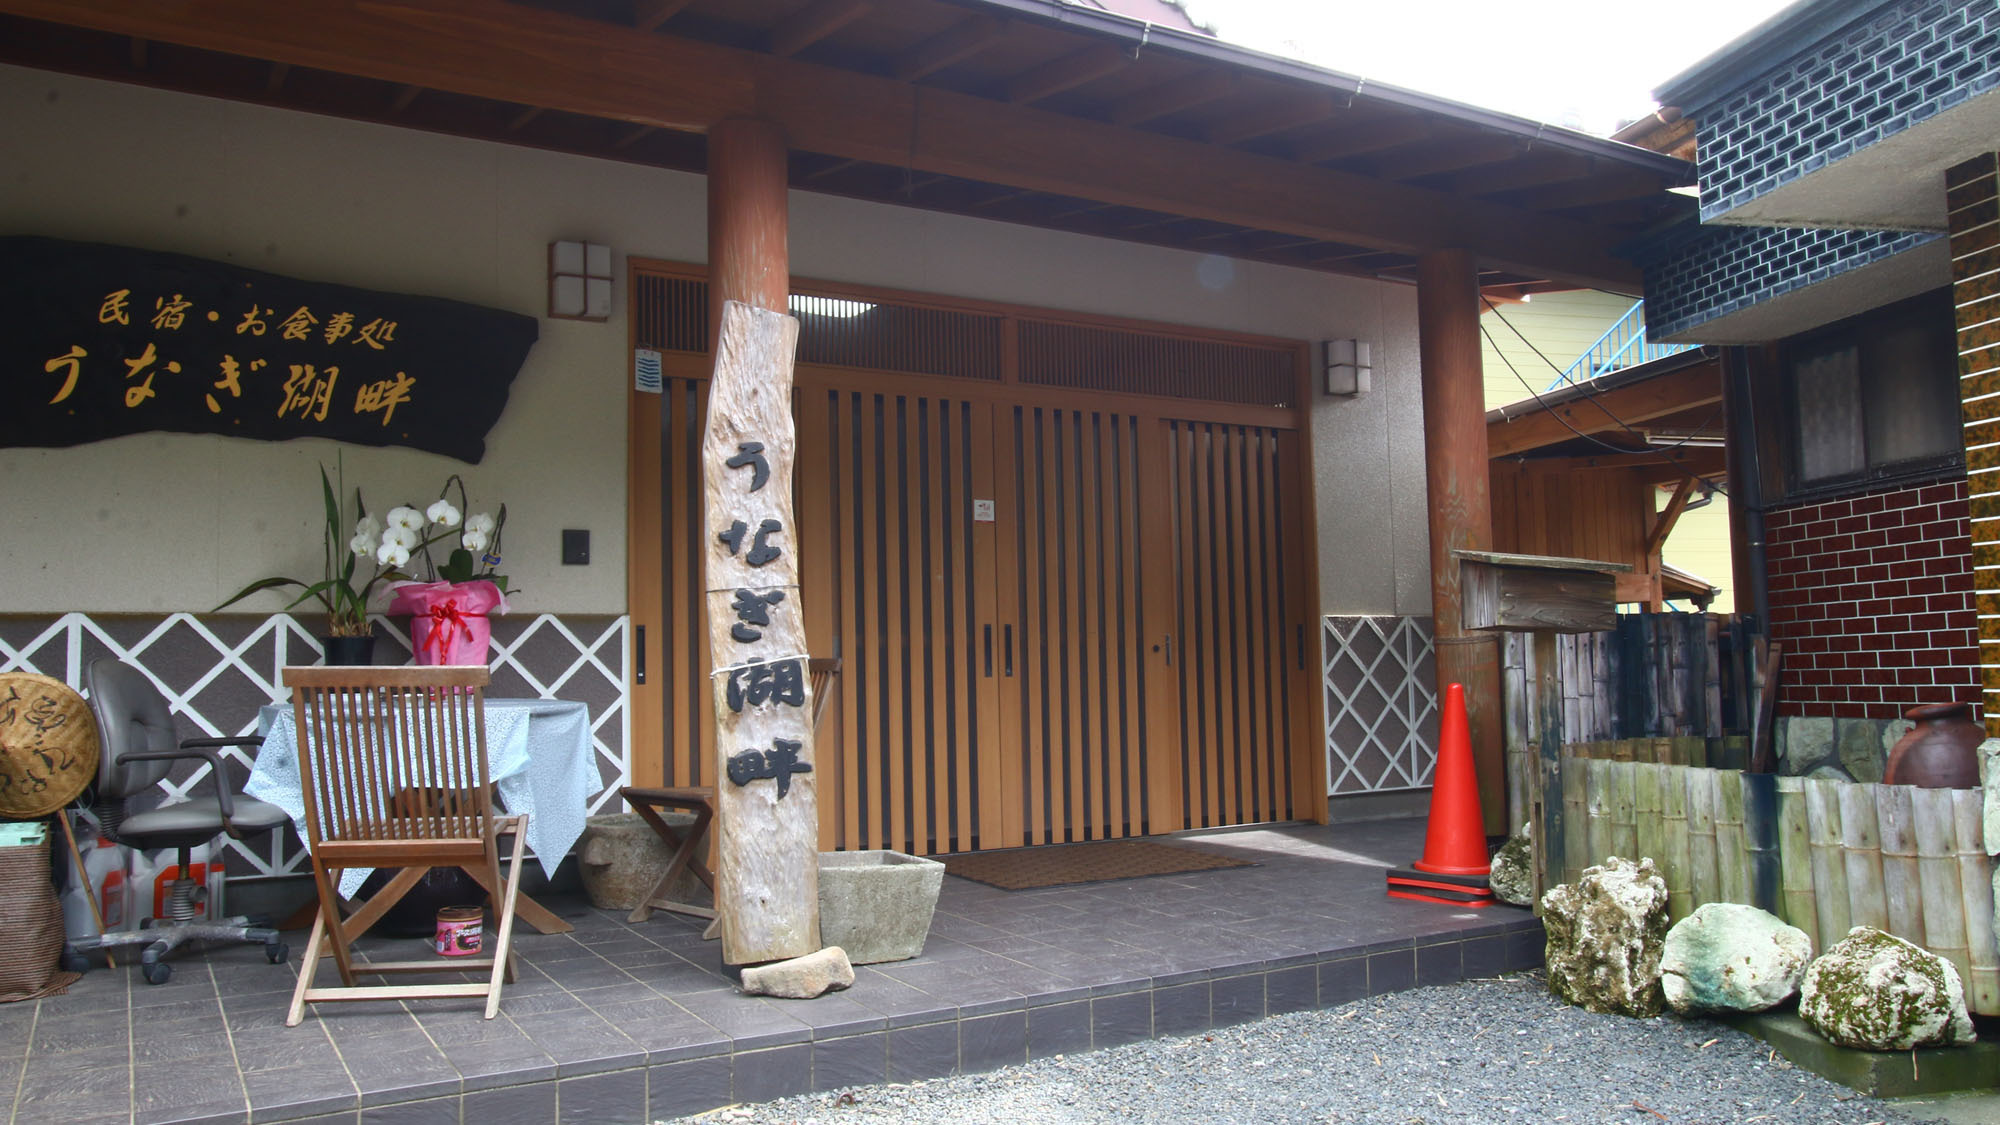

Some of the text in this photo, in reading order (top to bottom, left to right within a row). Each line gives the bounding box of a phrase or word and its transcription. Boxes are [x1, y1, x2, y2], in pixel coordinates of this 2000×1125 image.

[45, 343, 416, 426] うなぎ湖畔
[719, 441, 812, 800] うなぎ湖畔
